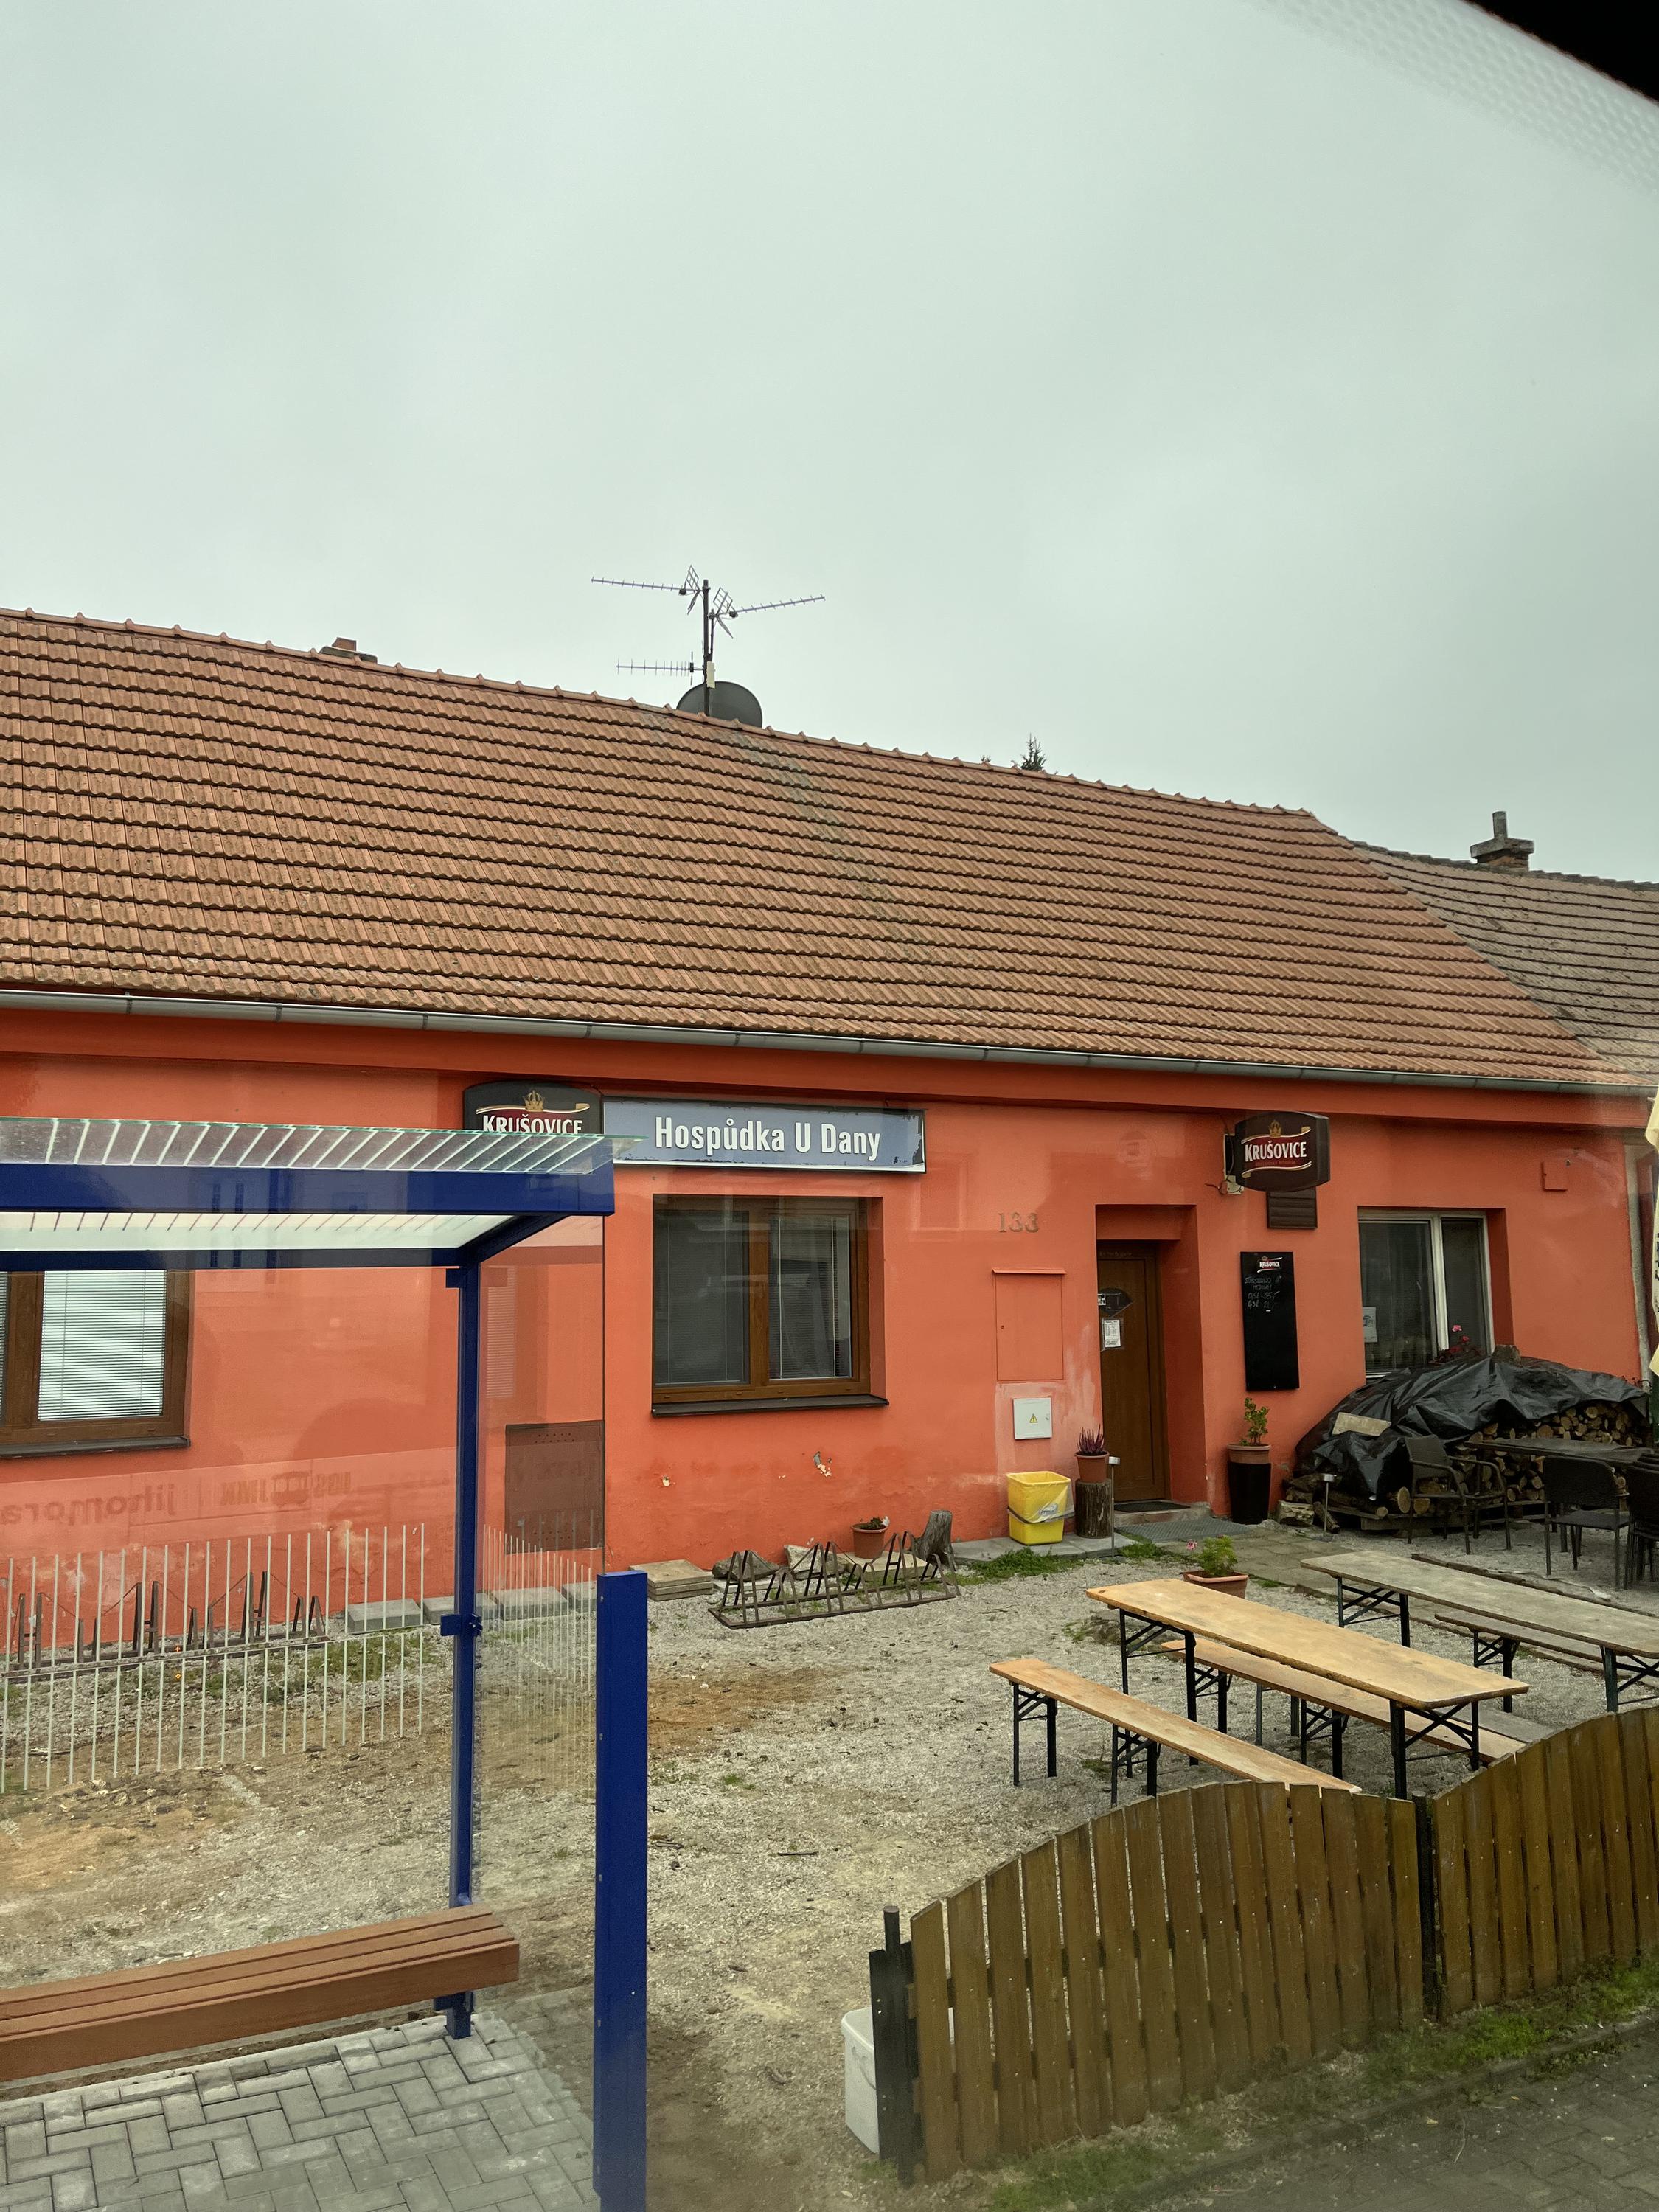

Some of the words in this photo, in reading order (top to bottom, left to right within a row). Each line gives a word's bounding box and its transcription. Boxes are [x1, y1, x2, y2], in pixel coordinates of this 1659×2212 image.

[482, 1113, 582, 1135] KRUŠOVICE
[655, 1116, 785, 1156] Hospůdka
[795, 1122, 810, 1152] U
[821, 1123, 880, 1161] Dany
[1245, 1140, 1307, 1162] KRUŠOVICE
[998, 1211, 1039, 1234] 133
